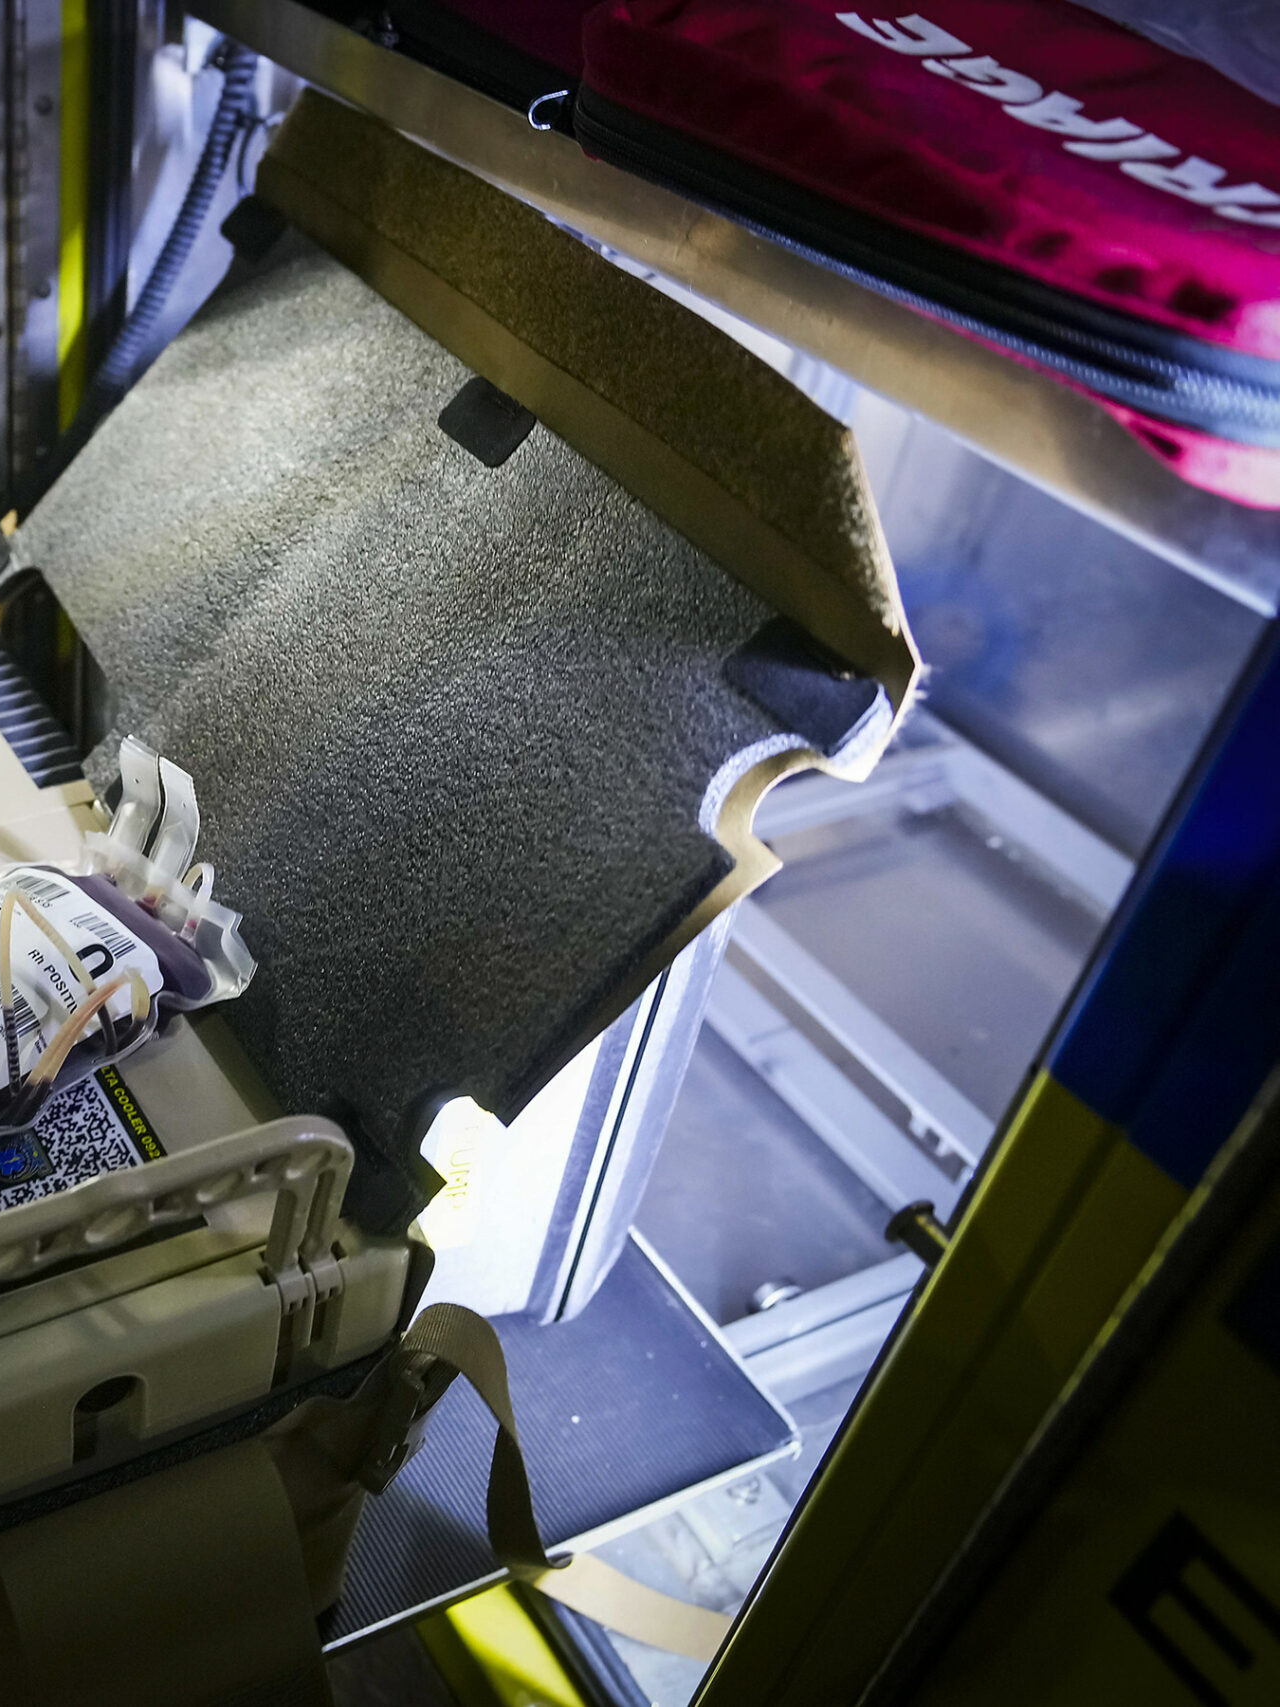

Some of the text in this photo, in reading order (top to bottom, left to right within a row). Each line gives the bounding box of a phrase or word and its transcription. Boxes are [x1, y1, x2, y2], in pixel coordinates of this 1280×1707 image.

[28, 949, 45, 965] Rh
[112, 1086, 147, 1136] COOLER
[139, 1134, 162, 1162] 092
